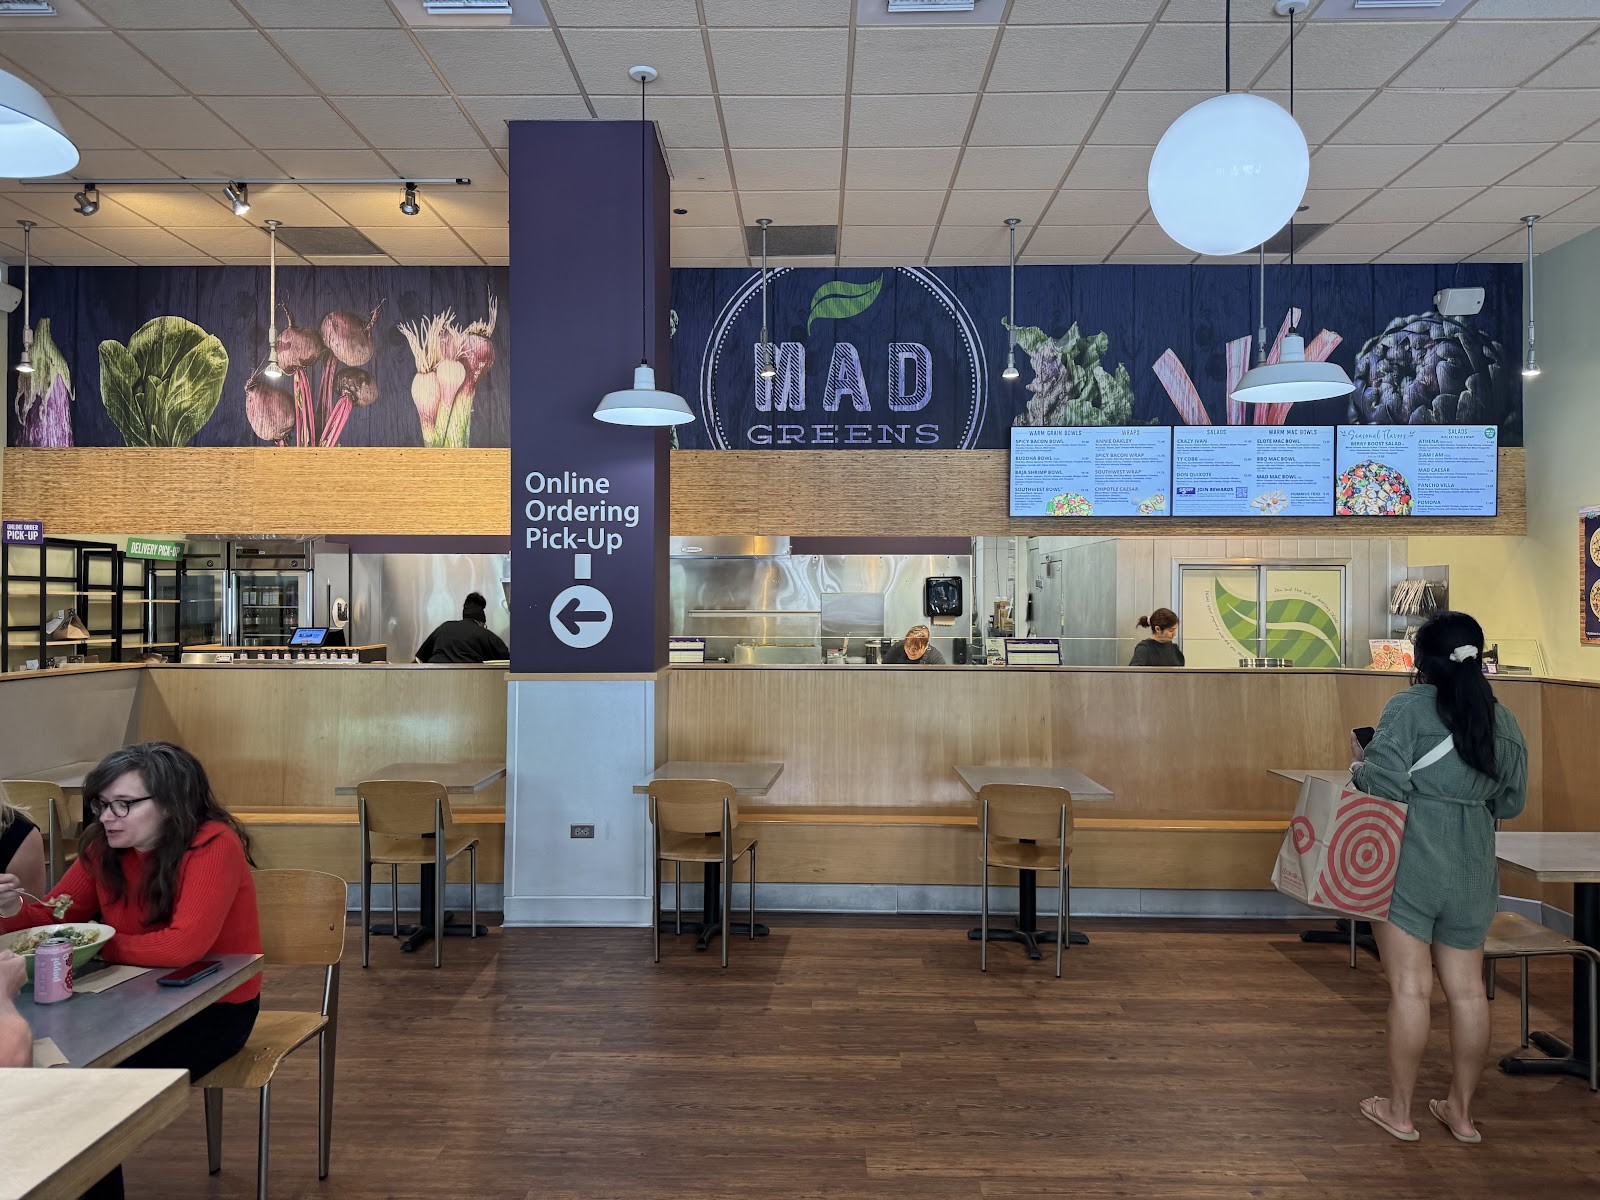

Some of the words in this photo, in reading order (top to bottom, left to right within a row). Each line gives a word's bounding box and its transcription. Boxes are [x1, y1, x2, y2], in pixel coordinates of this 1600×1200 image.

[753, 342, 933, 412] MAD
[747, 424, 940, 444] GREENS
[1348, 429, 1381, 440] Seasonal
[1381, 429, 1406, 440] Flavors
[525, 471, 610, 494] Online
[525, 499, 639, 527] Ordering
[7, 530, 39, 541] PICK-UP
[526, 527, 623, 554] Pick-Up
[131, 542, 158, 555] DELIVERY
[157, 545, 181, 557] PICK-UP
[51, 957, 61, 983] poppi
